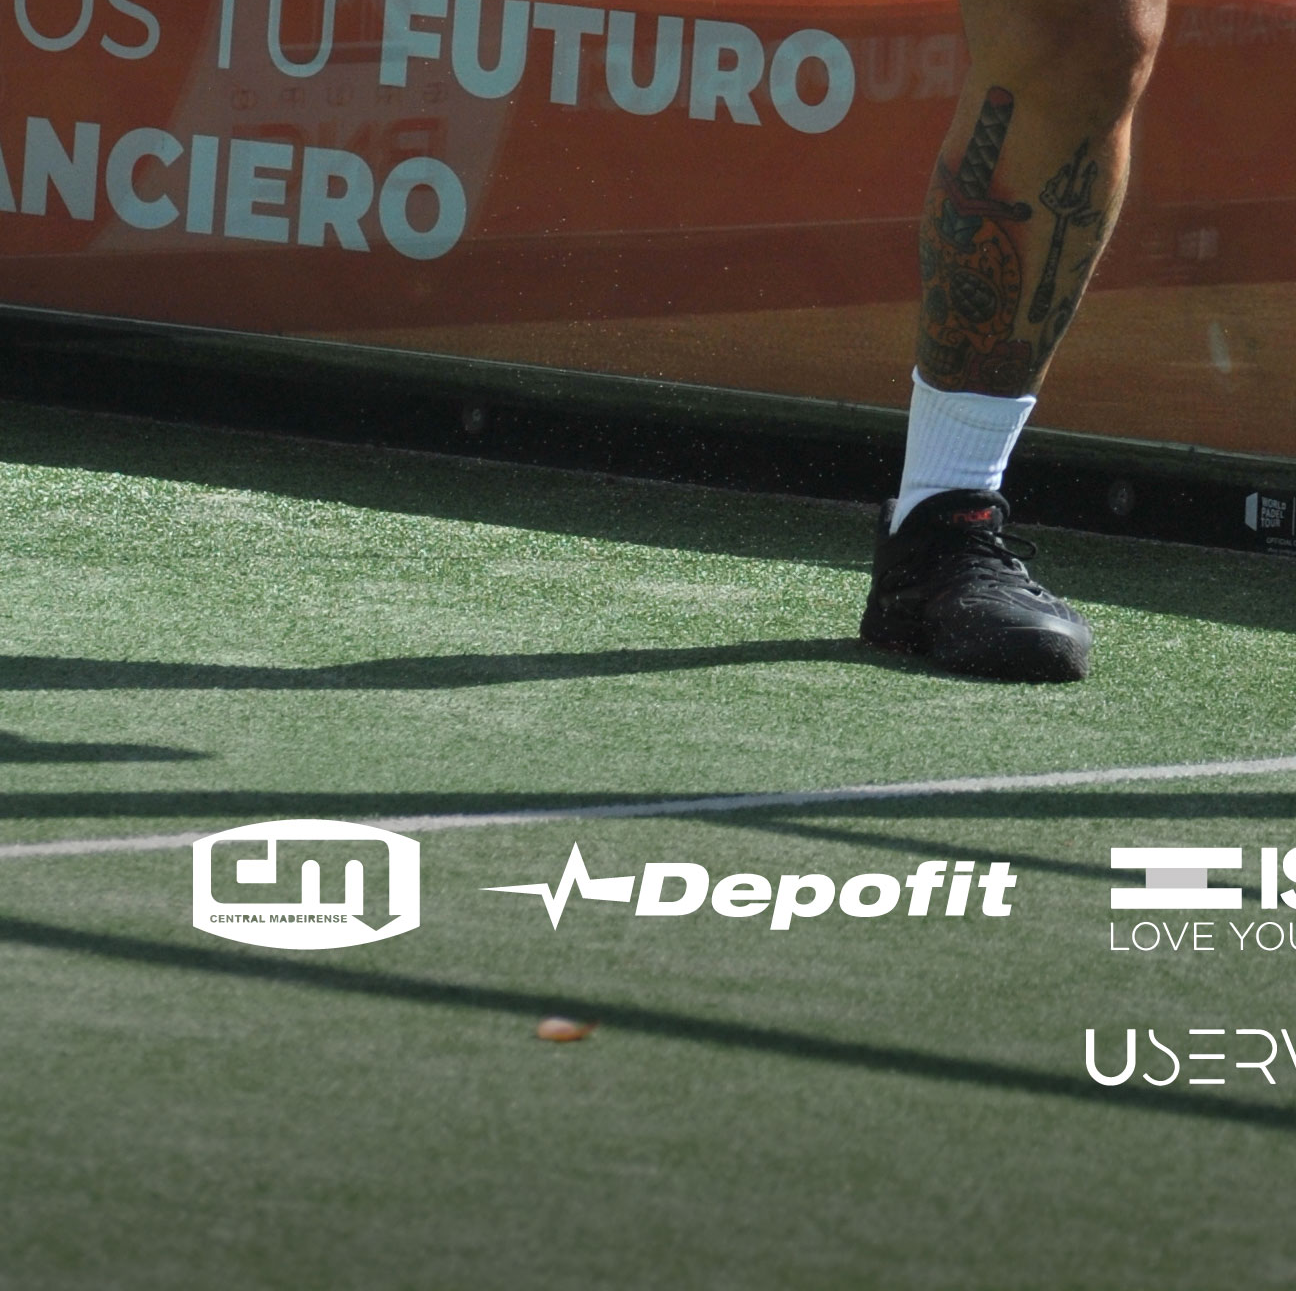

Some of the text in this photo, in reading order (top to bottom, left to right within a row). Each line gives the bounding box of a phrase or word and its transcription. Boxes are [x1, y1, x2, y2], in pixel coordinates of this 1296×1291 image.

[1261, 496, 1287, 511] WORLD
[1260, 507, 1285, 519] PADEL
[1260, 518, 1281, 528] TOUR
